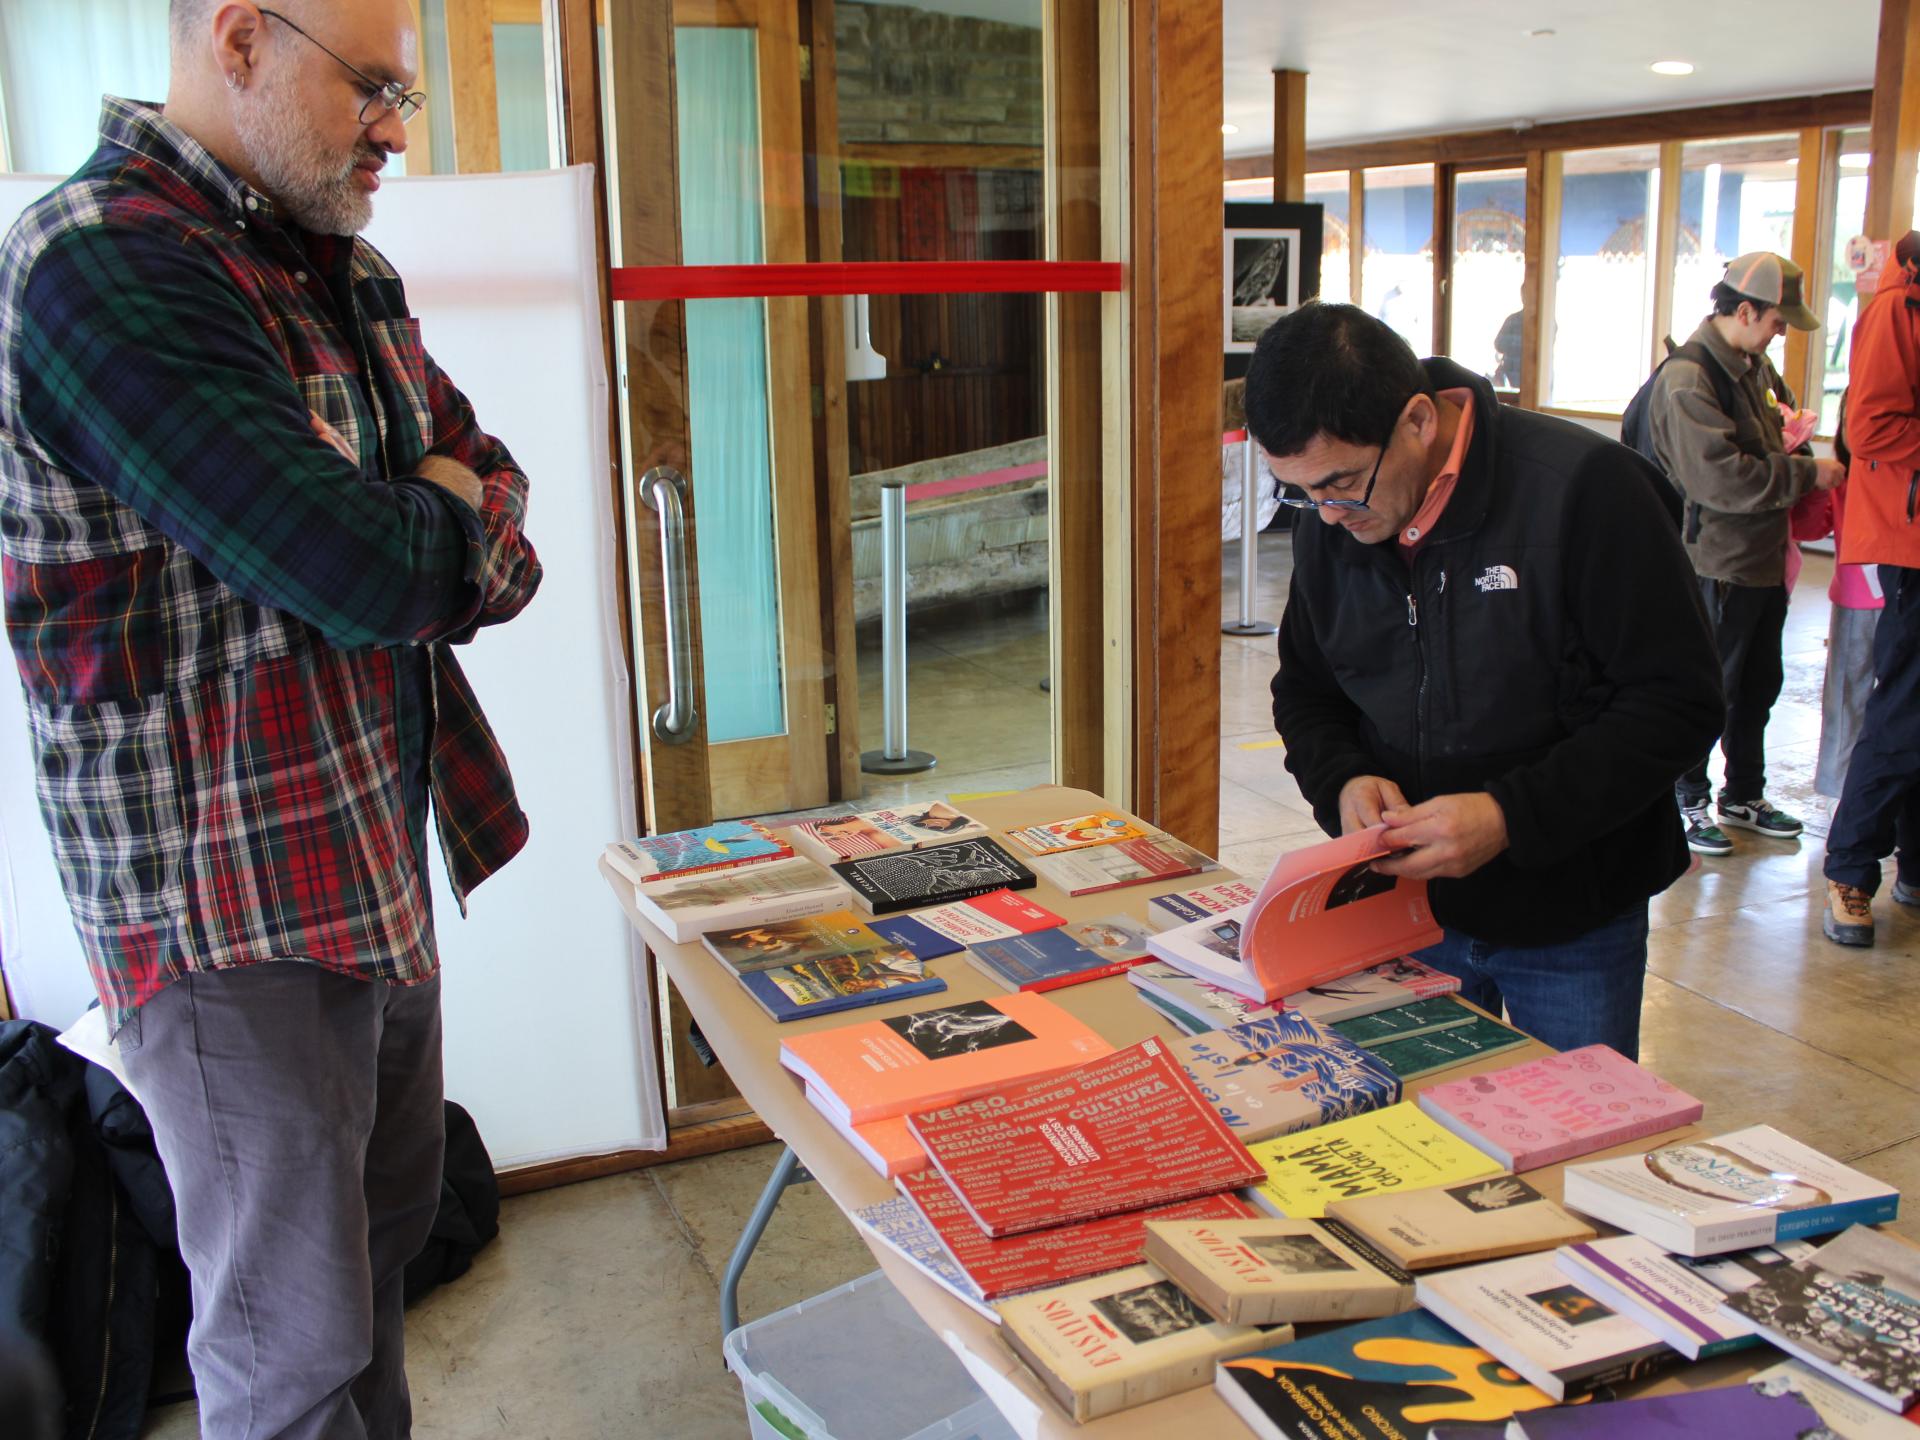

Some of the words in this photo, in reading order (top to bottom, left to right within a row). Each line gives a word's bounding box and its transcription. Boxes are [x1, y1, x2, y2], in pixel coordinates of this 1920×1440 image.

[1475, 574, 1502, 586] NORTH
[1485, 566, 1500, 575] THE
[1481, 582, 1500, 592] FACE
[931, 916, 972, 938] ASAMBLEA
[1079, 1058, 1154, 1090] ORALIDAD
[916, 1093, 1009, 1125] VERSO
[978, 1086, 1077, 1120] HABLANTES
[1065, 1078, 1170, 1121] CULTURA
[1011, 1102, 1072, 1123] FEMINISMO
[919, 1117, 975, 1134] ORALIDAD
[927, 1119, 1012, 1145] LECTURA
[934, 1122, 1037, 1153] PEDAGOGÍA
[1038, 1123, 1079, 1167] DOCUMENTOS
[1066, 1124, 1101, 1162] LITERARIOS
[1104, 1135, 1155, 1154] LECTURA
[1141, 1133, 1187, 1152] GESTOS
[1001, 1158, 1056, 1175] SONORAS
[1779, 1220, 1809, 1233] CEREBRO
[1810, 1217, 1821, 1229] DE
[1822, 1215, 1835, 1226] PAN
[1026, 1229, 1083, 1245] NOVELAS
[988, 1257, 1052, 1275] DISCURSO
[1277, 1375, 1323, 1421] QUEBRADA
